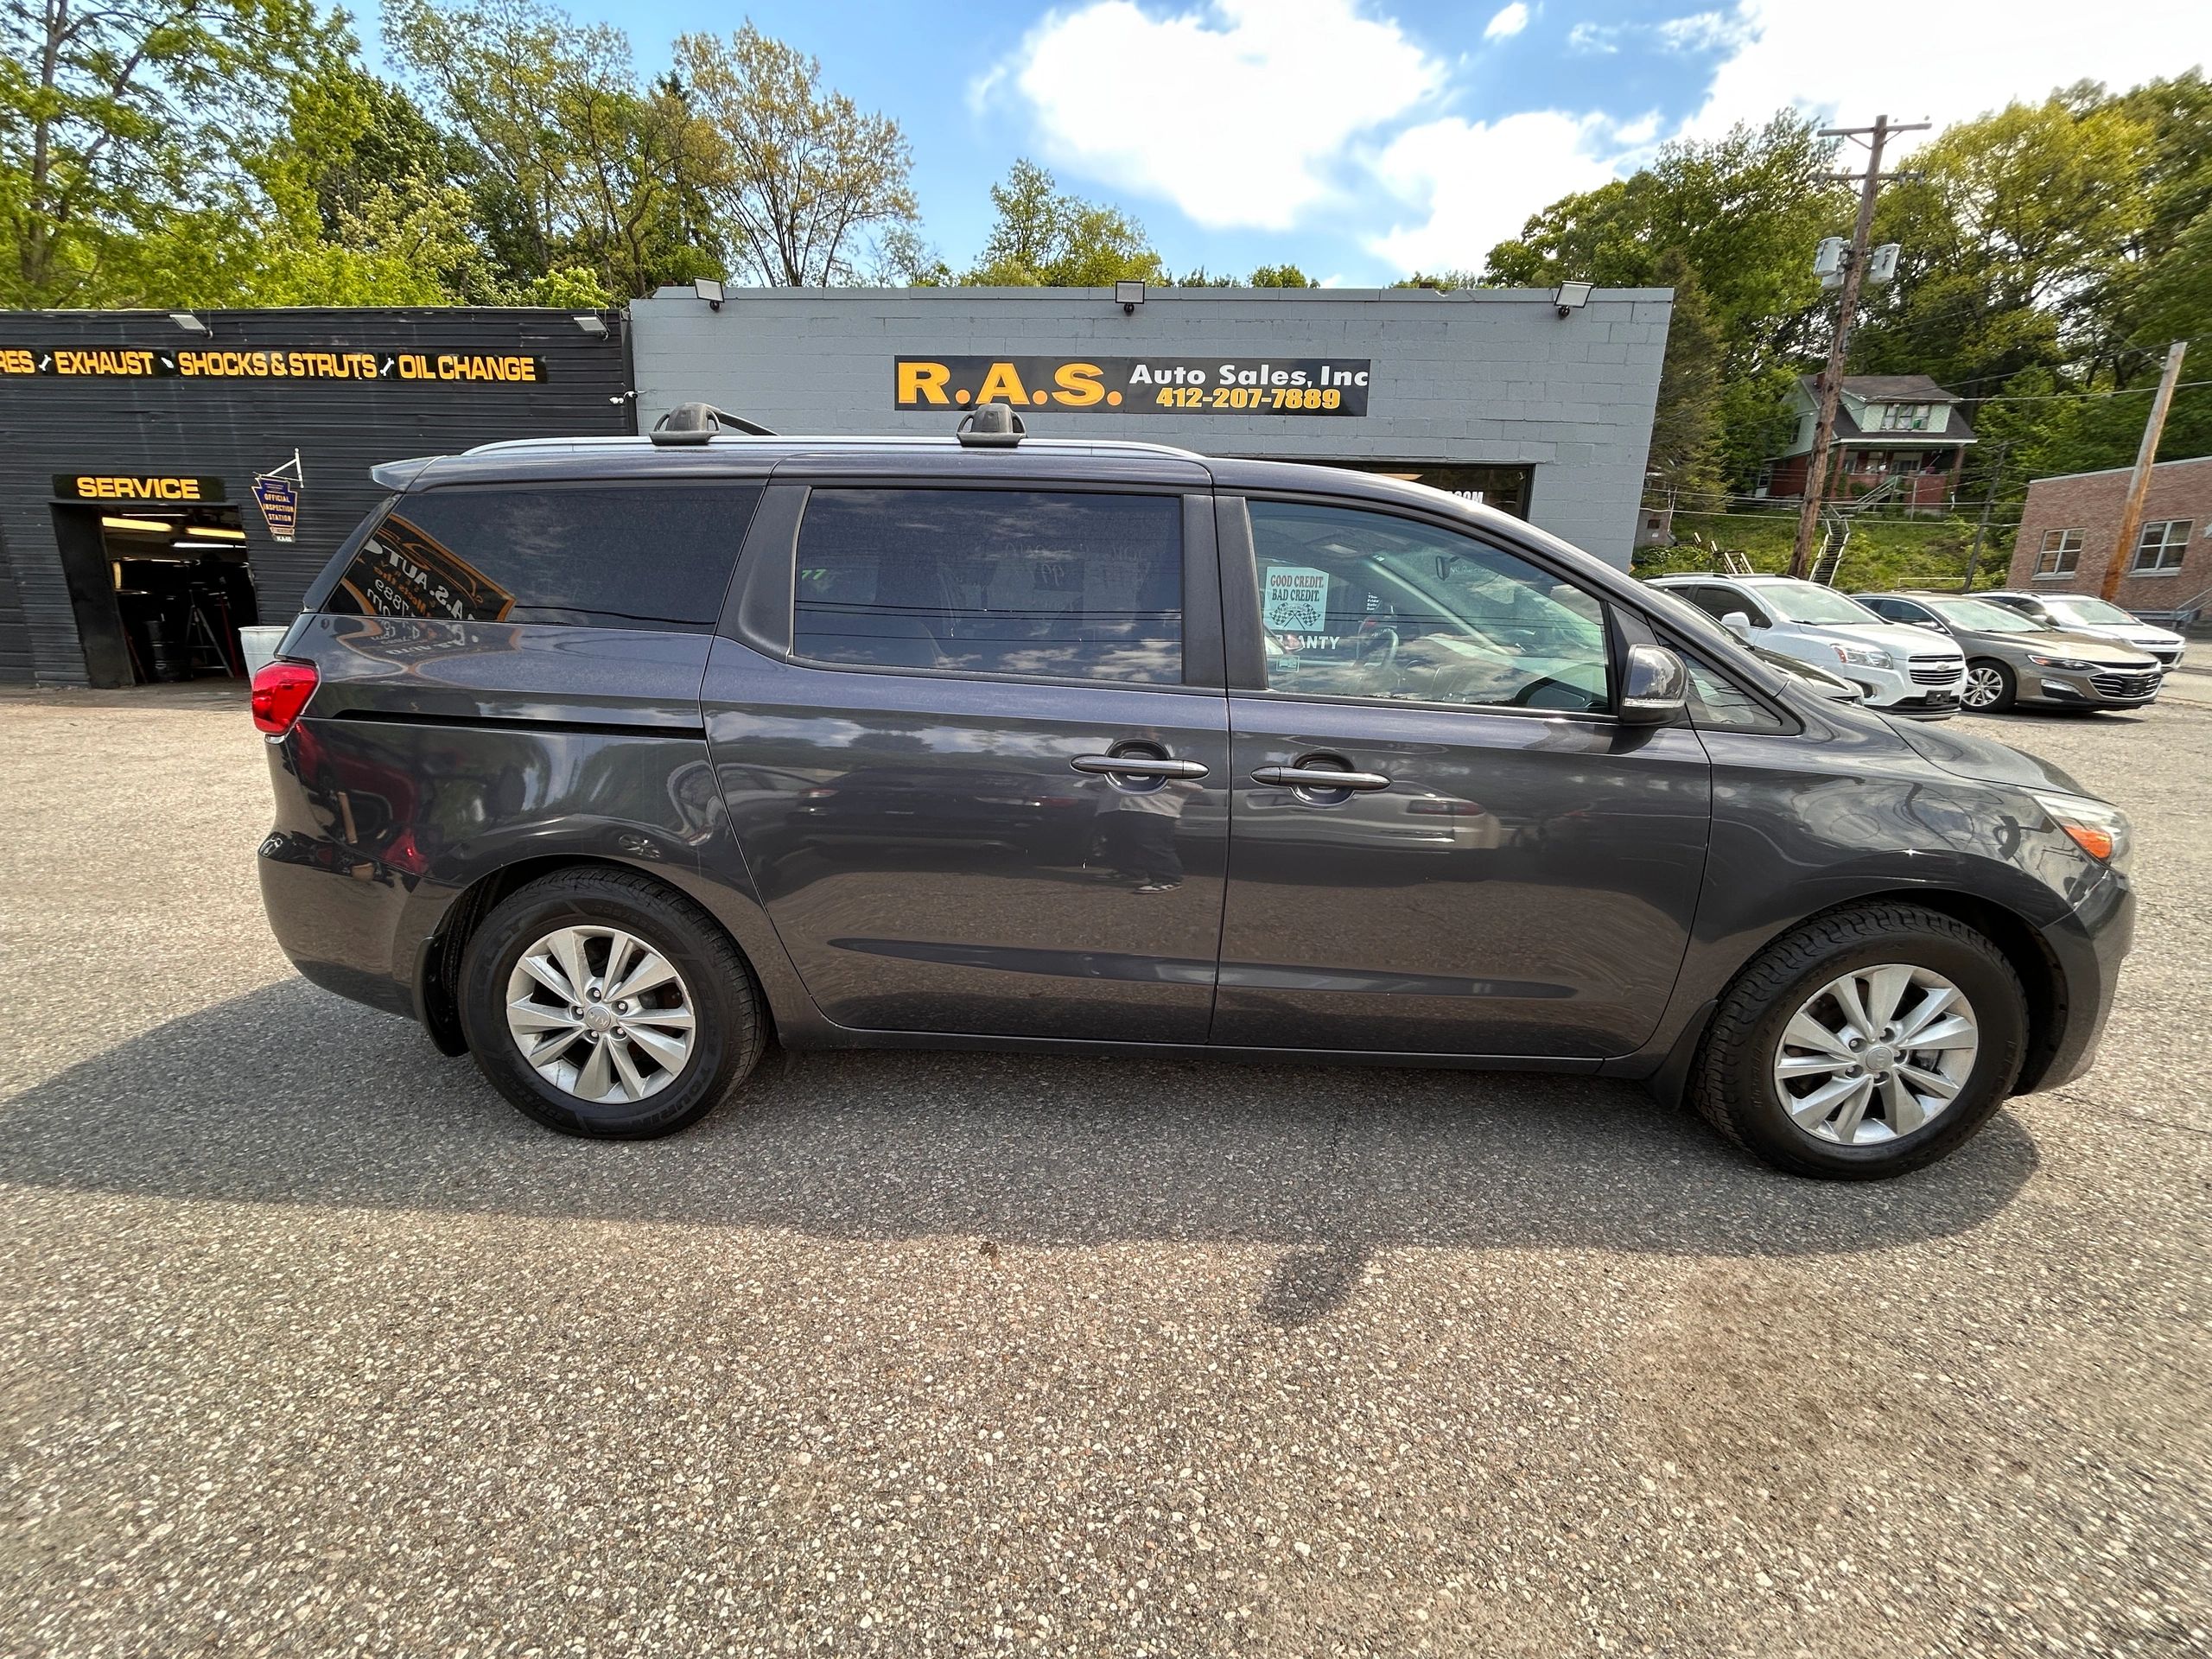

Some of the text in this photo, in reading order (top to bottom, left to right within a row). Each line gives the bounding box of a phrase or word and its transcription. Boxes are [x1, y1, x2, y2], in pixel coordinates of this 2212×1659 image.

[54, 352, 154, 374] EXHAUST
[178, 353, 268, 377] SHOCKS
[270, 353, 288, 377] &
[288, 353, 378, 378] STRUTS
[398, 355, 436, 379] OIL
[437, 356, 536, 381] CHANGE
[899, 362, 1369, 406] R.A.S. Auto Sales, Inc
[1156, 387, 1341, 410] 412-207-7889
[77, 477, 200, 499] SERVICE
[264, 493, 290, 503] OFFICIAL
[263, 504, 295, 512] INSPECTION
[268, 513, 292, 522] STATION
[1270, 575, 1324, 588] GOOD CREDIT.
[1272, 588, 1319, 601] BAD CREDIT.
